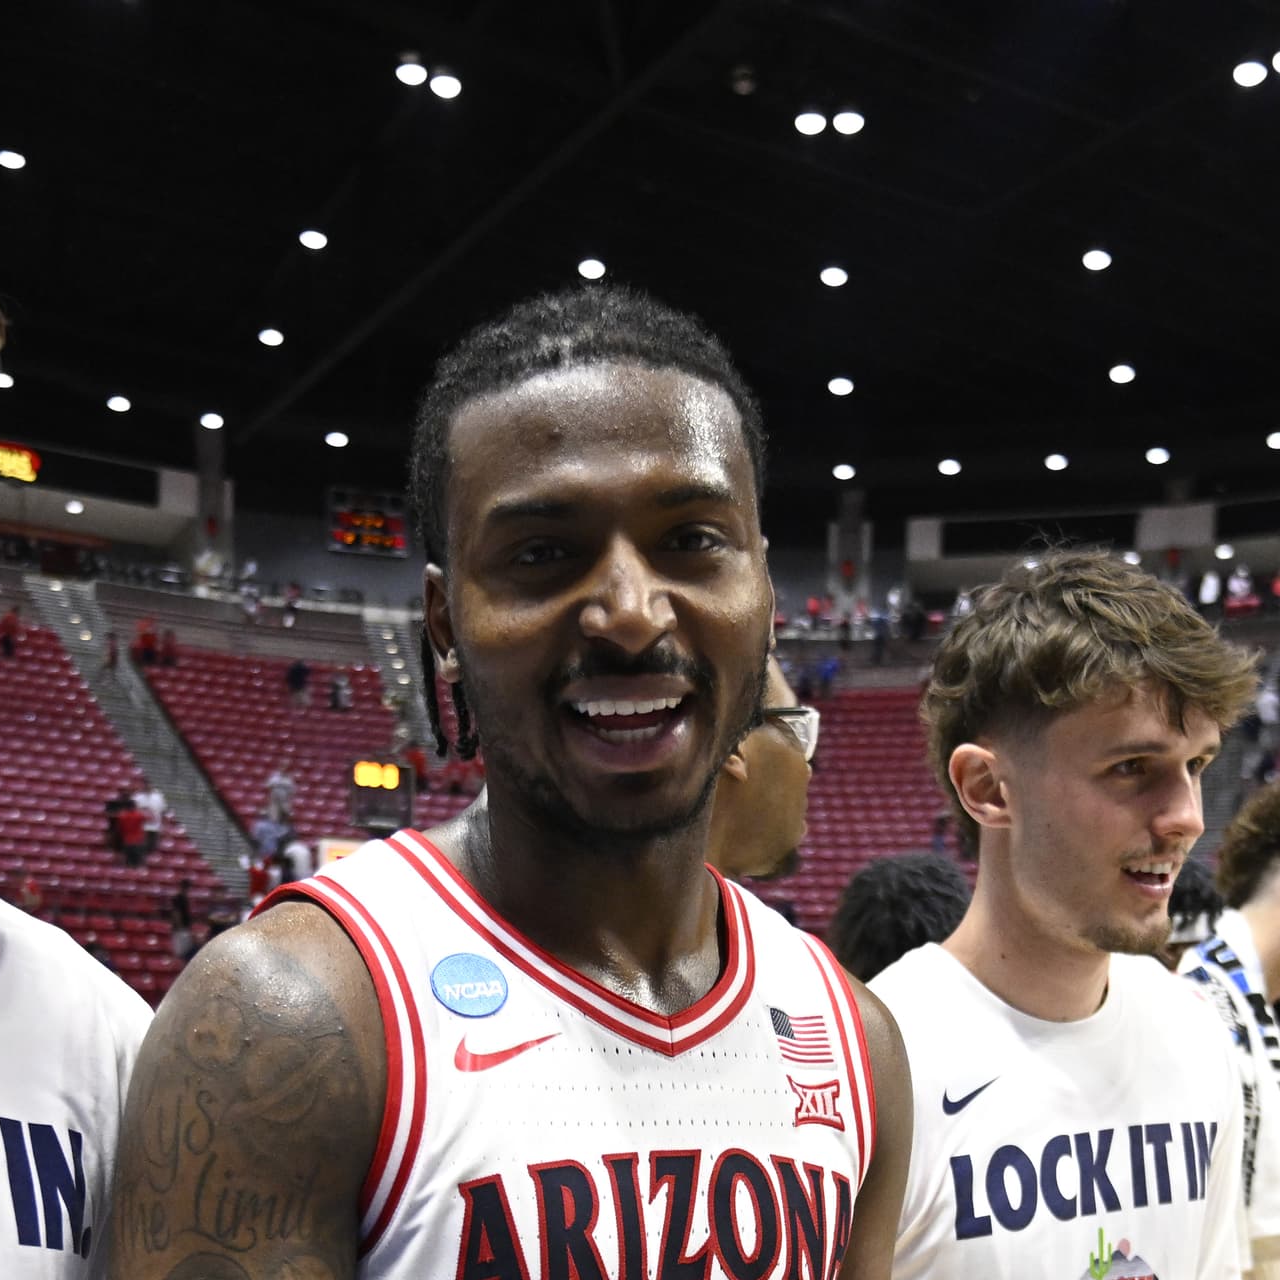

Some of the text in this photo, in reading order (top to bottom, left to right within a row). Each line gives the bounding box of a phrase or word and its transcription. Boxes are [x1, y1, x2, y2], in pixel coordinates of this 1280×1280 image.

[444, 979, 504, 1001] NCAA
[950, 1128, 1122, 1241] LOCK
[1128, 1122, 1173, 1208] IT
